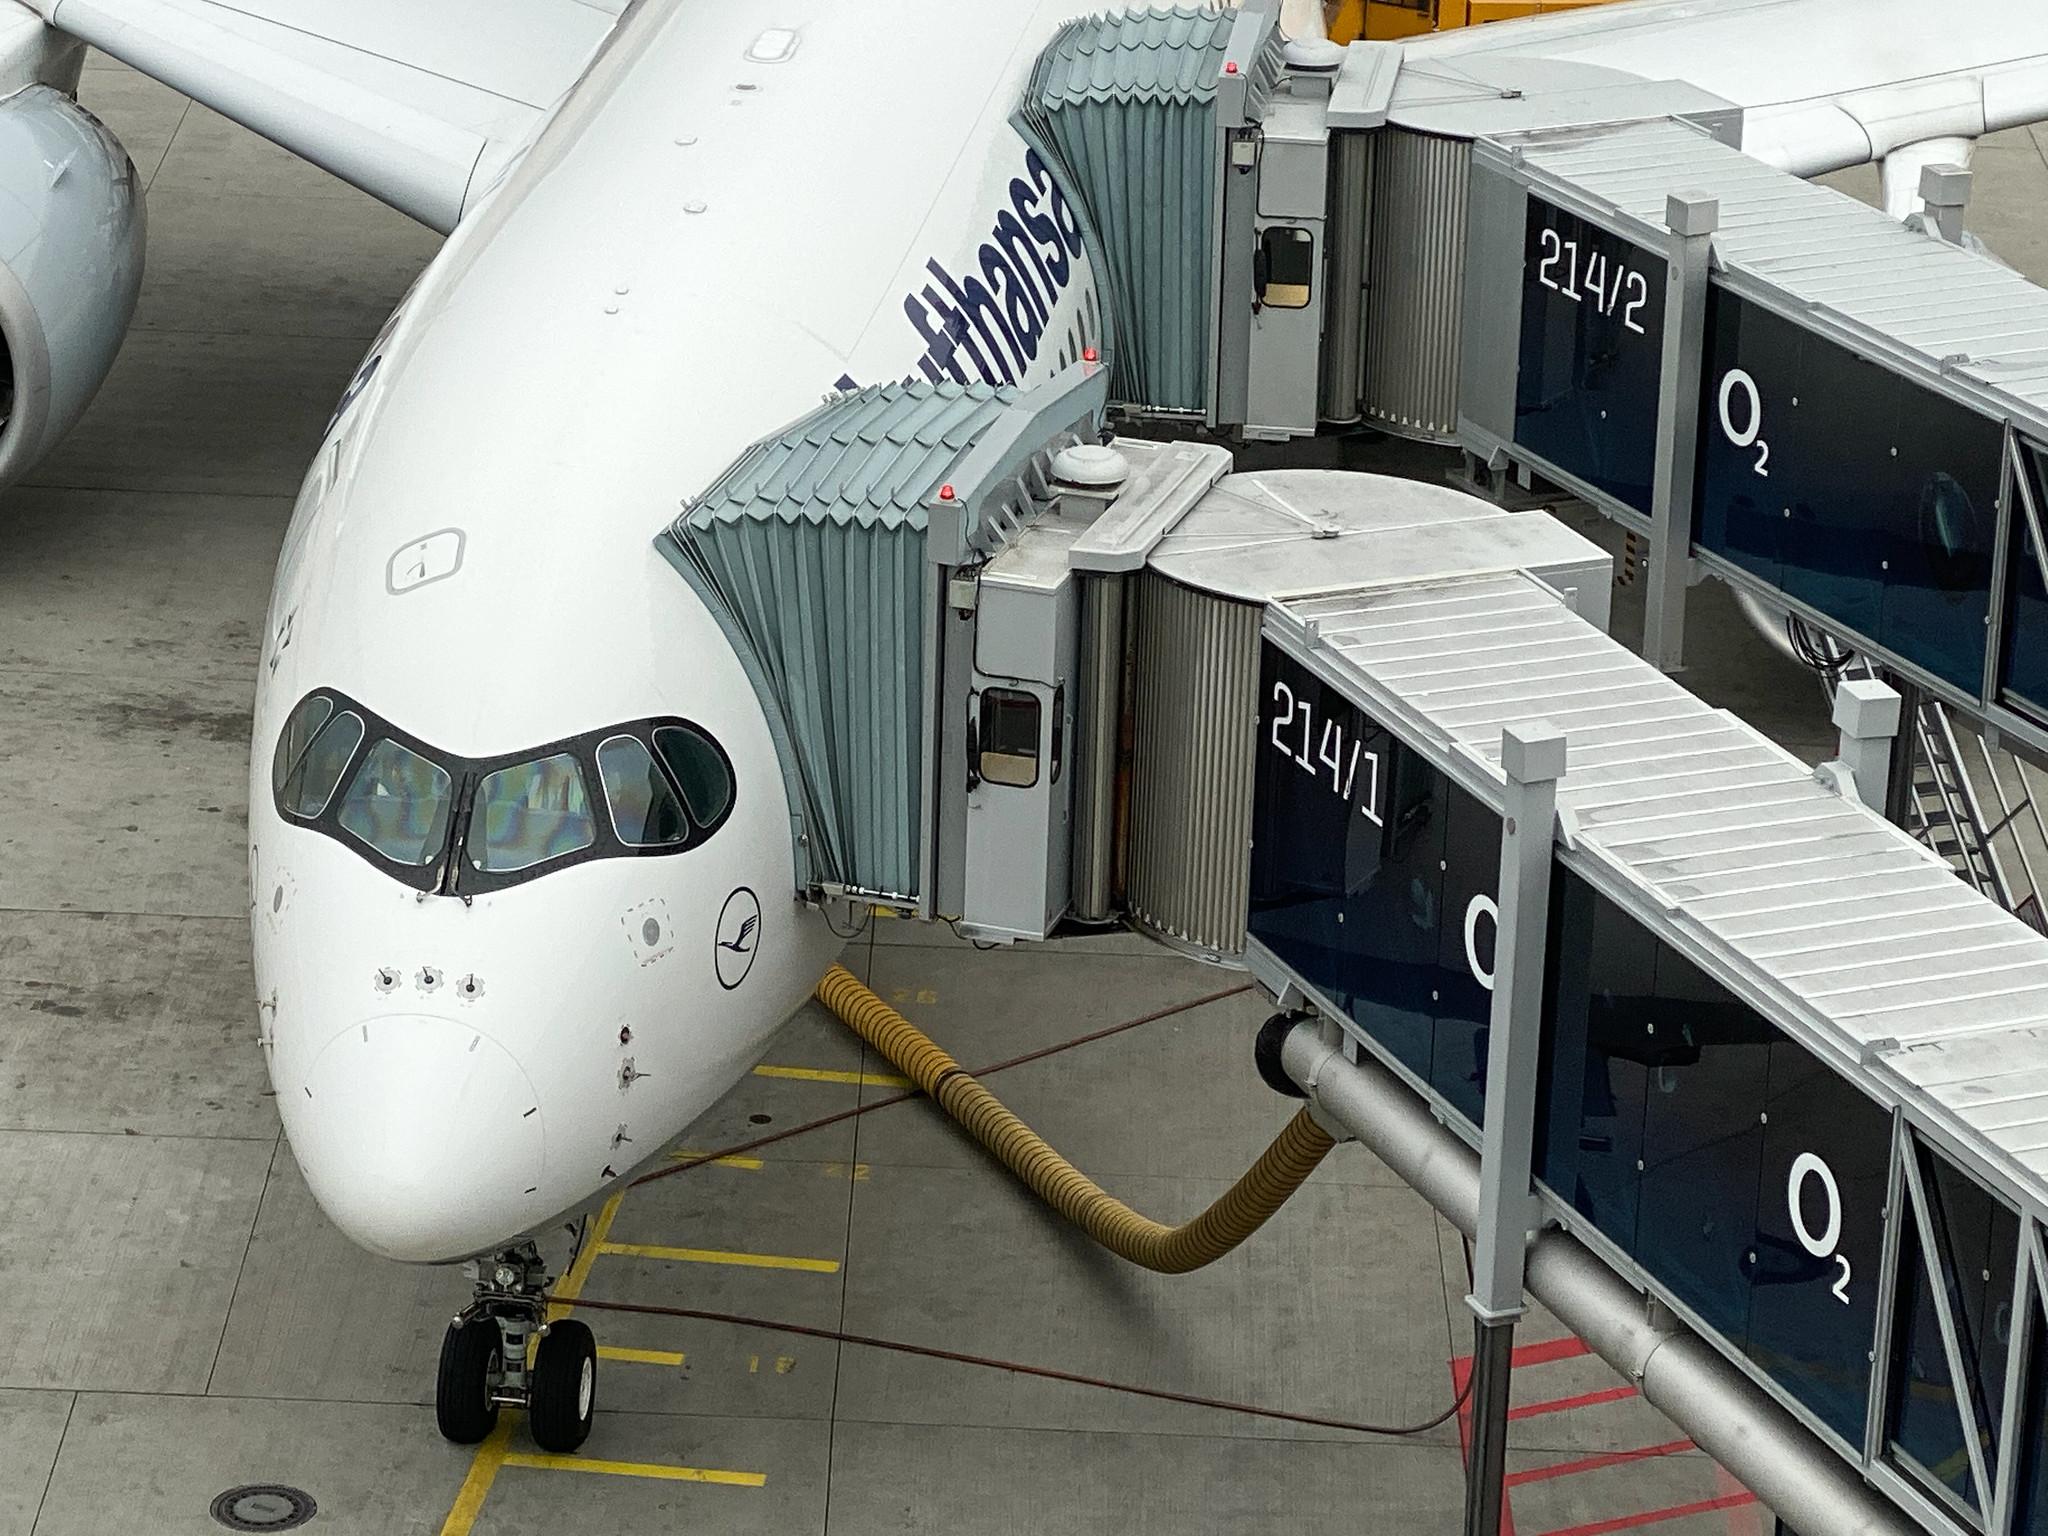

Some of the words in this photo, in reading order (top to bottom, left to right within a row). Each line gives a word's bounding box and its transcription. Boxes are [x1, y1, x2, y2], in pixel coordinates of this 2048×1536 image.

[834, 147, 1082, 390] fthansa
[1539, 228, 1647, 334] 214/2
[1271, 681, 1384, 828] 214/1
